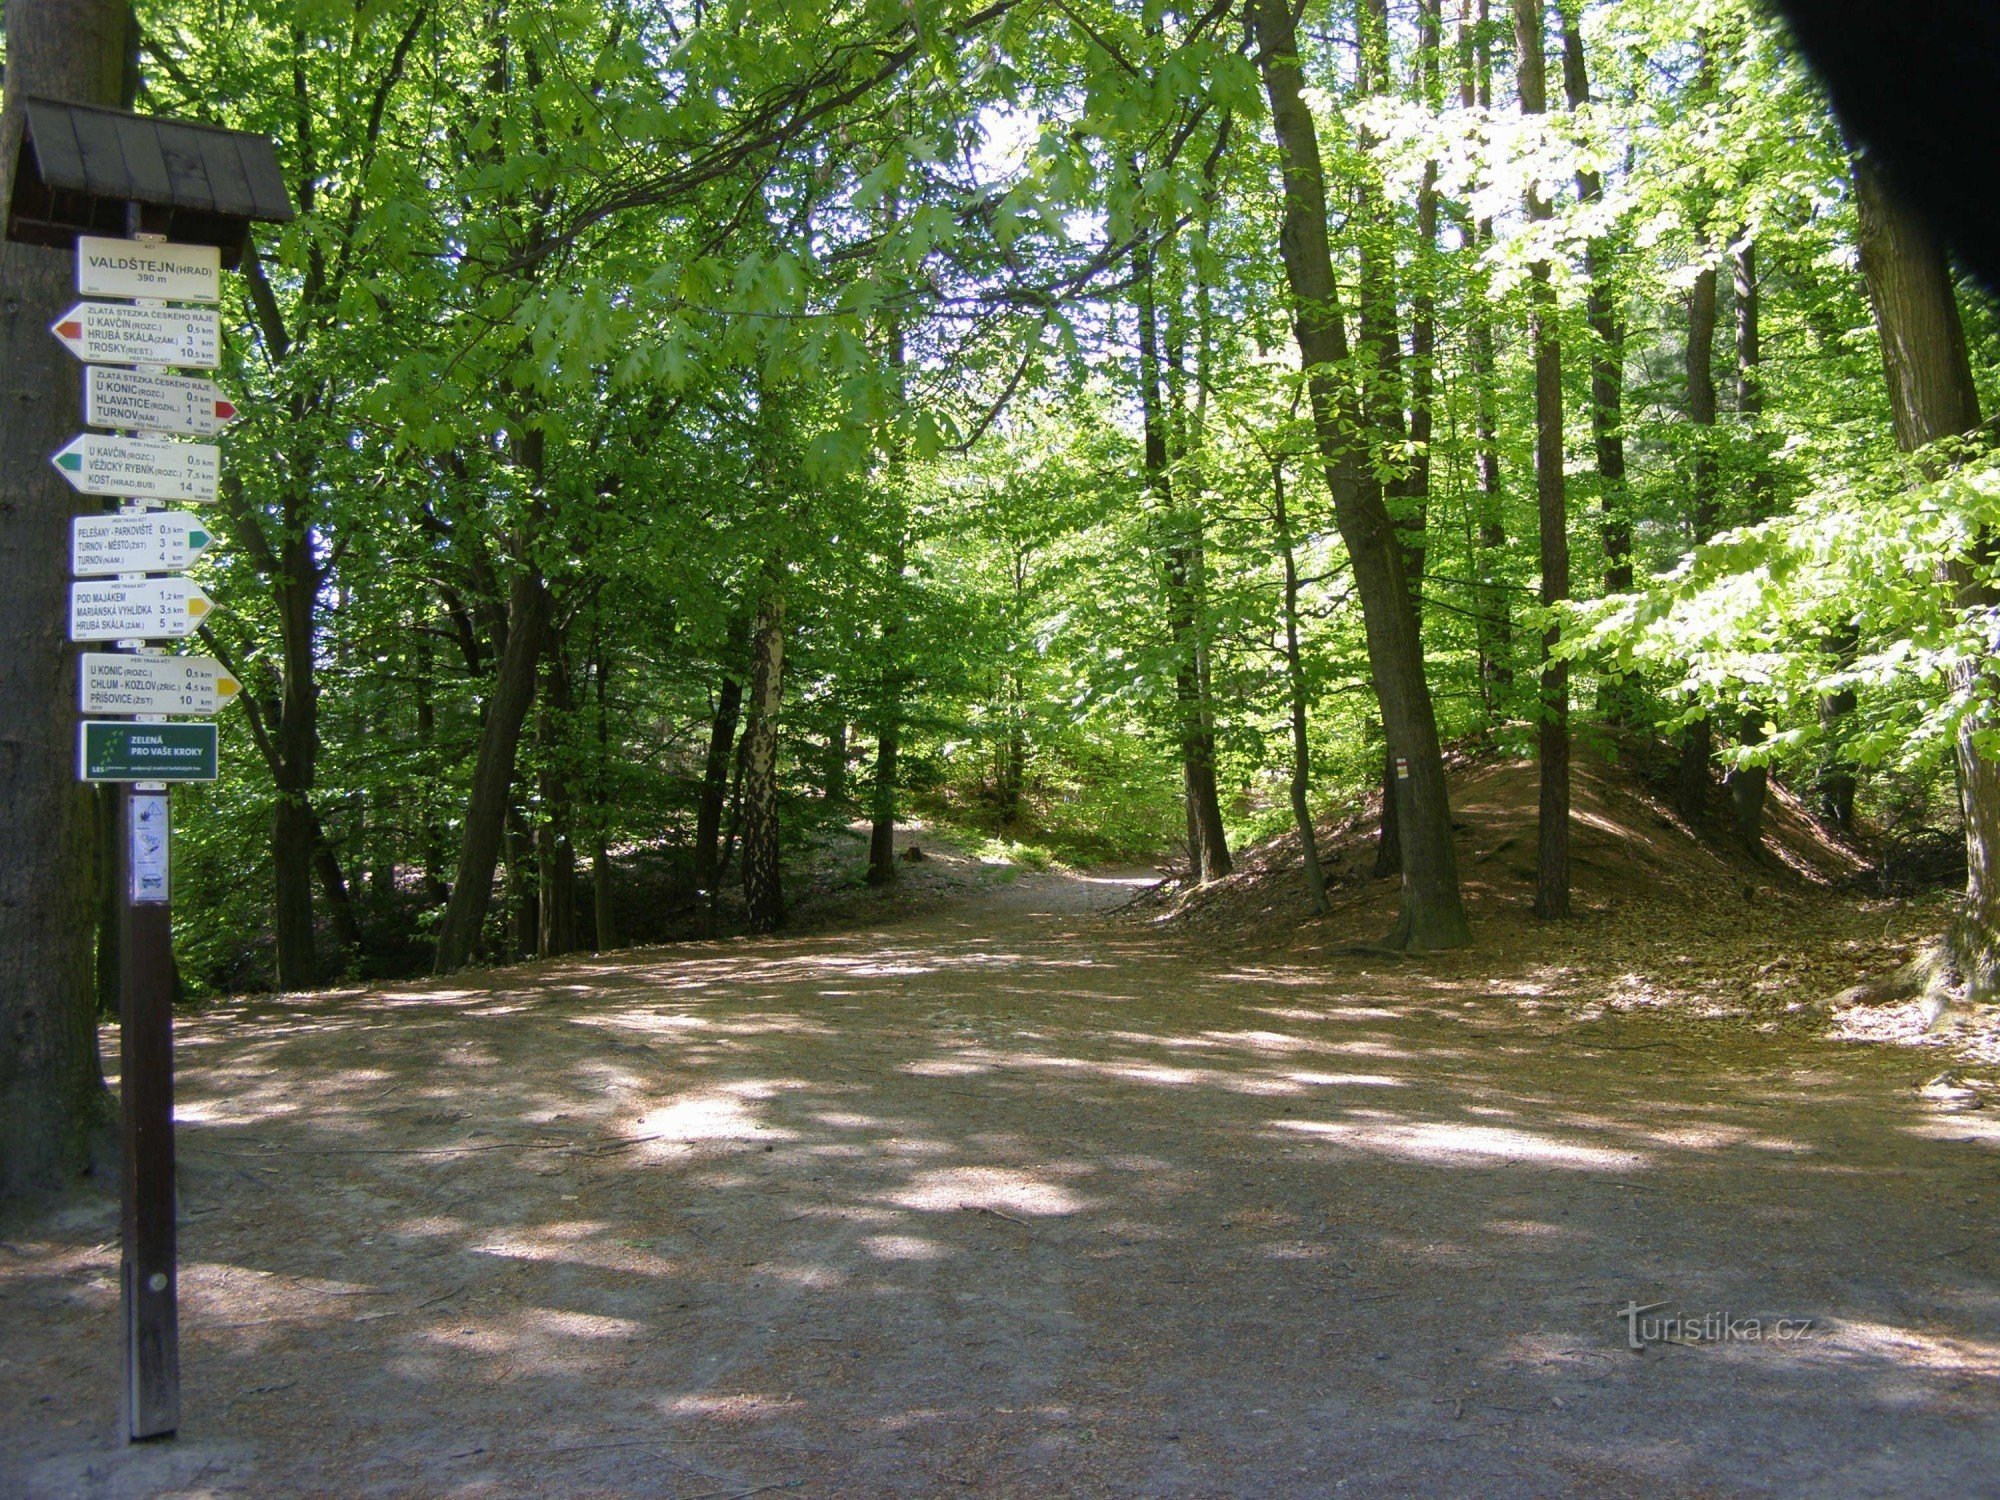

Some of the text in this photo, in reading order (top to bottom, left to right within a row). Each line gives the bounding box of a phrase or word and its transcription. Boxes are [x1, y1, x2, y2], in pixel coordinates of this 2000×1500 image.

[138, 274, 154, 282] 390
[88, 307, 114, 315] ZLATÁ
[117, 309, 151, 317] STEZKA
[151, 311, 190, 320] ČESKÉHO
[88, 318, 94, 326] U
[88, 330, 120, 340] HRUBÁ
[187, 336, 193, 345] 3
[181, 348, 200, 358] 10,5
[97, 372, 210, 391] ZLATÁ STEZKA ČESKÉHO RÁJE
[97, 382, 103, 390] U
[188, 404, 191, 412] 1
[186, 417, 192, 425] 4
[90, 447, 94, 455] U
[89, 460, 122, 471] VĚŽICKÝ
[181, 482, 192, 491] 14
[79, 527, 110, 538] PELEŠANY
[115, 525, 153, 535] PARKOVIŠTĚ
[78, 542, 103, 551] TURNOV
[160, 539, 165, 547] 3
[77, 594, 91, 603] POD
[93, 592, 126, 602] MAJÁKEM
[77, 606, 116, 616] MARIÁNSKÁ
[119, 605, 152, 615] VYHLÍDKA
[77, 619, 100, 630] HRUBÁ
[160, 619, 165, 627] 5
[91, 666, 96, 674] U
[91, 680, 119, 689] CHLUM
[180, 696, 192, 704] 10
[131, 735, 163, 744] ZELENÁ
[151, 746, 172, 755] VAŠE
